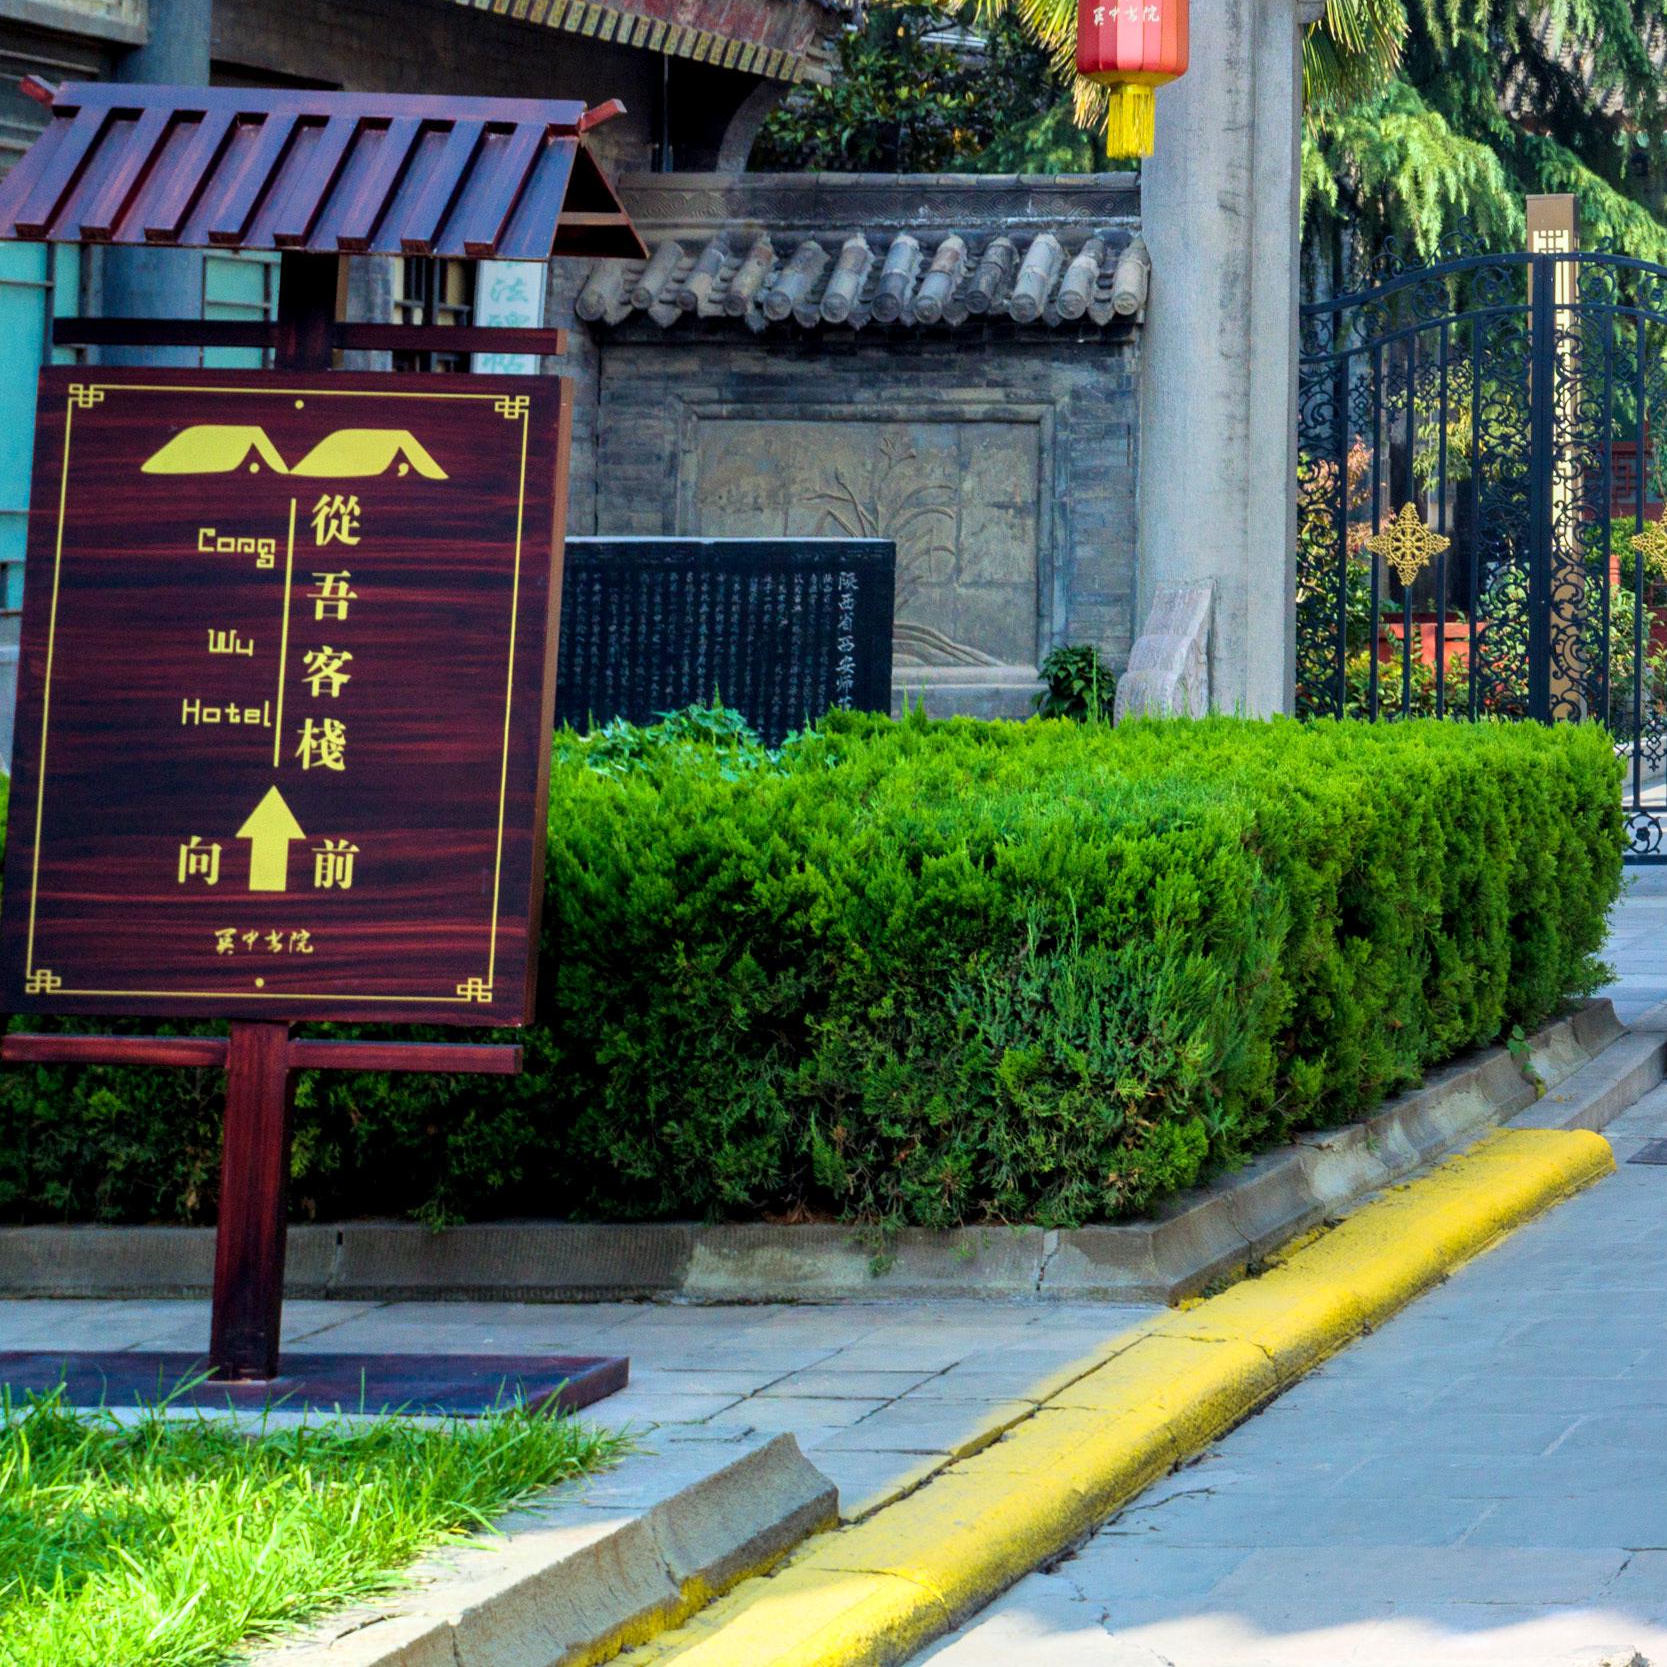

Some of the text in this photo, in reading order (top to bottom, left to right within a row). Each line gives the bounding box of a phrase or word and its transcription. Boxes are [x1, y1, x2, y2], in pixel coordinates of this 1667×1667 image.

[197, 528, 276, 569] Cong
[207, 628, 254, 656] Wu
[181, 698, 272, 727] Hotel
[177, 835, 360, 890] 向 前
